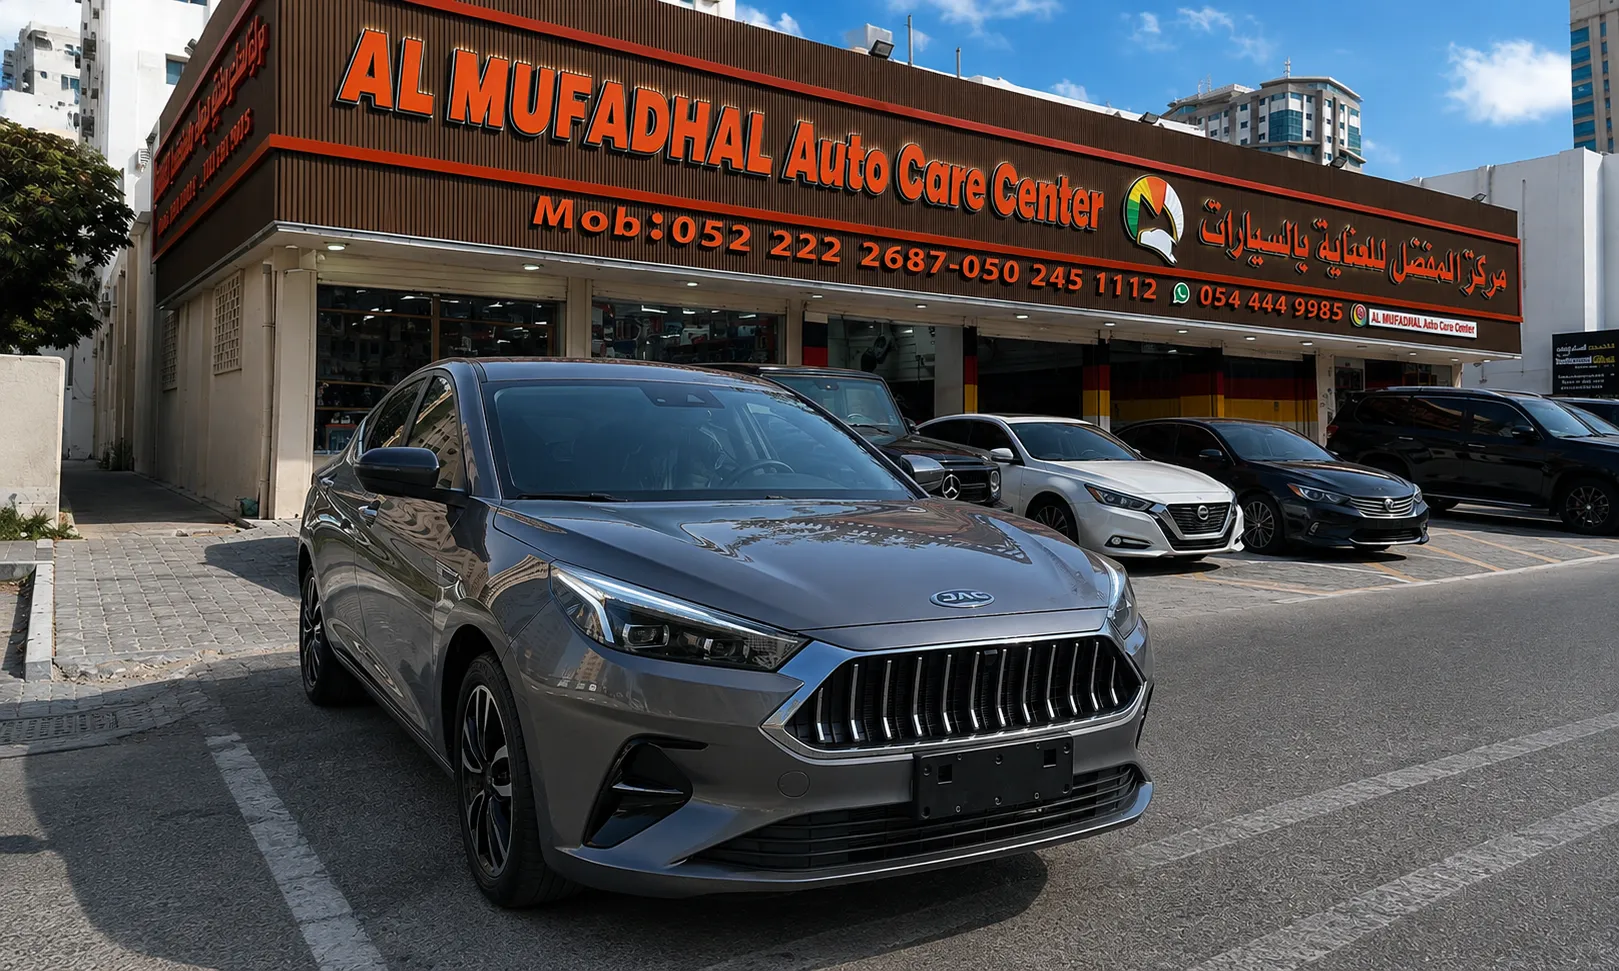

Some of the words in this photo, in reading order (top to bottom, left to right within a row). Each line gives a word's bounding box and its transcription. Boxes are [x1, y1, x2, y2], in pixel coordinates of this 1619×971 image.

[336, 27, 435, 118] AL
[447, 48, 773, 178] MUFADHAL
[782, 119, 890, 196] Auto
[895, 142, 986, 213] Care
[990, 161, 1105, 231] Center
[770, 229, 842, 264] 222
[1030, 262, 1084, 291] 245
[1096, 272, 1158, 300] 1112
[1199, 198, 1310, 275] بالسيارات
[1312, 217, 1387, 280] للعناية
[1389, 237, 1462, 287] المفضل
[1460, 249, 1507, 299] مركز
[1200, 284, 1242, 309] 054
[1247, 290, 1288, 315] 444
[1294, 298, 1345, 322] 9985
[1371, 311, 1381, 324] AL
